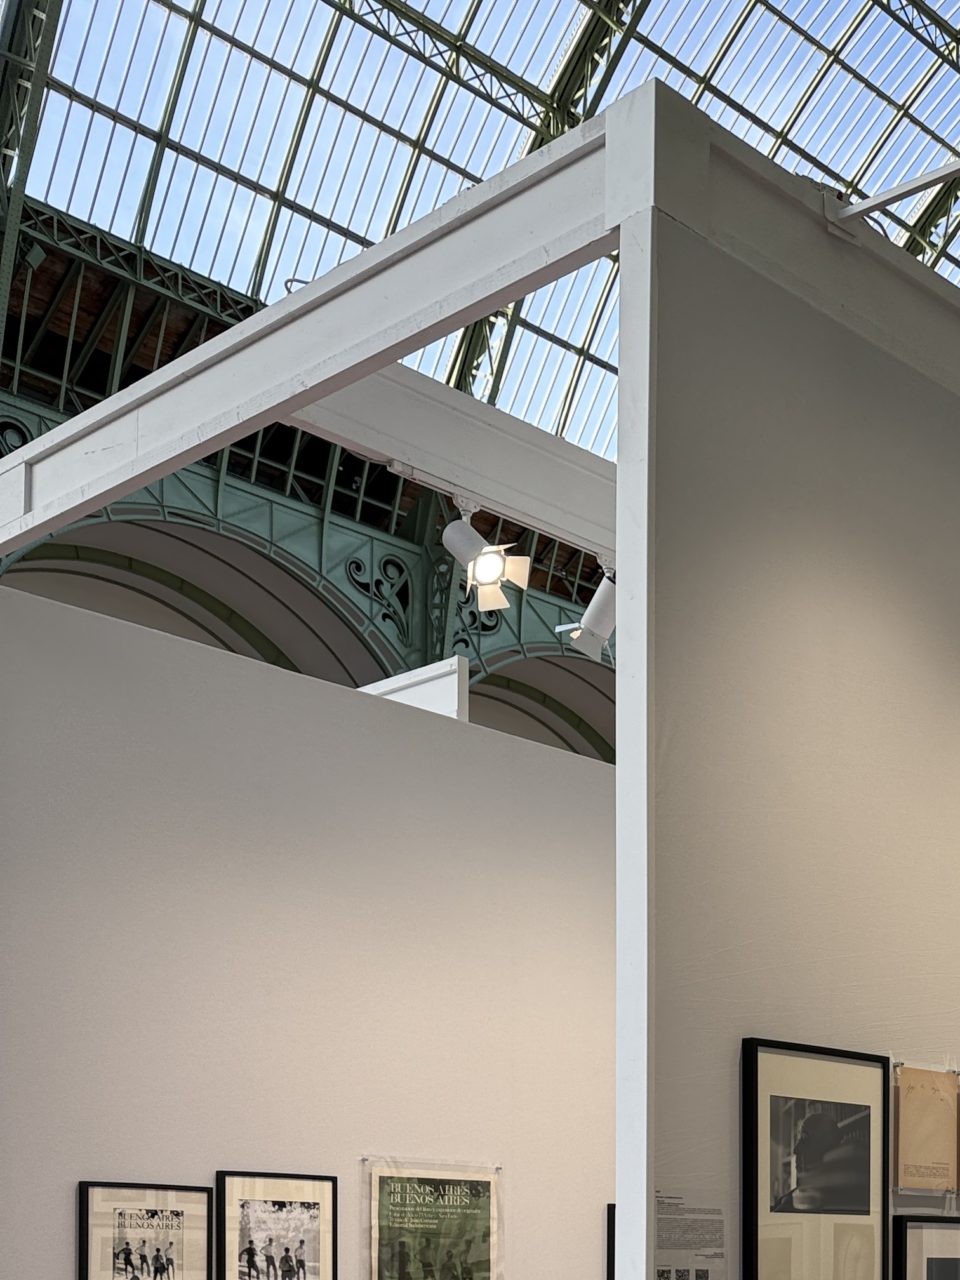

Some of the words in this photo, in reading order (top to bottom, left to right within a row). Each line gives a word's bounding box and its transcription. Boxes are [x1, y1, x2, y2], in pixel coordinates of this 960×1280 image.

[390, 1183, 435, 1194] BUENOS
[438, 1185, 470, 1195] AIRES
[390, 1194, 434, 1204] BUENOS
[437, 1195, 470, 1206] AIRES
[117, 1220, 155, 1229] BUENOS
[156, 1221, 182, 1231] AIRES
